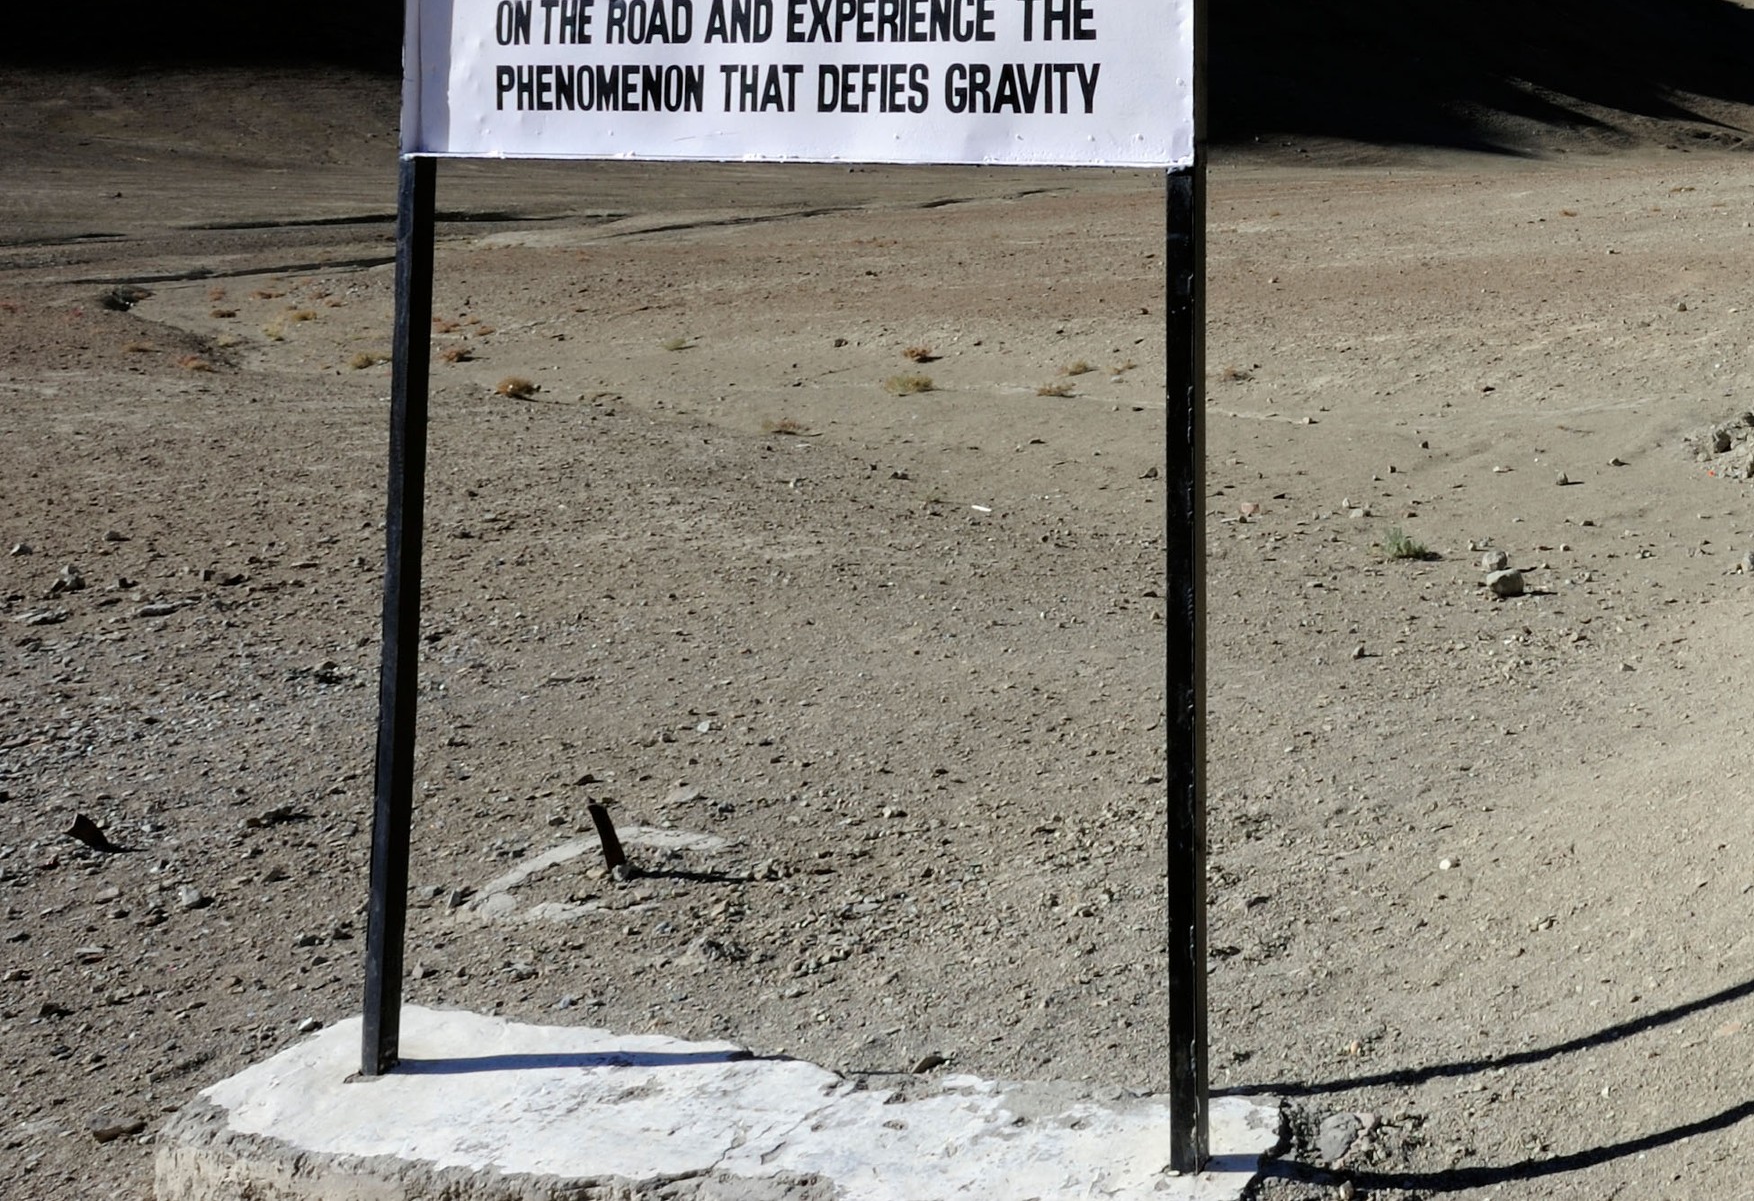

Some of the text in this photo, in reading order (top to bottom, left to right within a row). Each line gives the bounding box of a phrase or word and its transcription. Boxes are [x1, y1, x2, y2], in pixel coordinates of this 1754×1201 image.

[496, 0, 531, 46] ON
[540, 0, 592, 45] THE
[496, 63, 1101, 114] PHENOMENON THAT DEFIES GRAVITY
